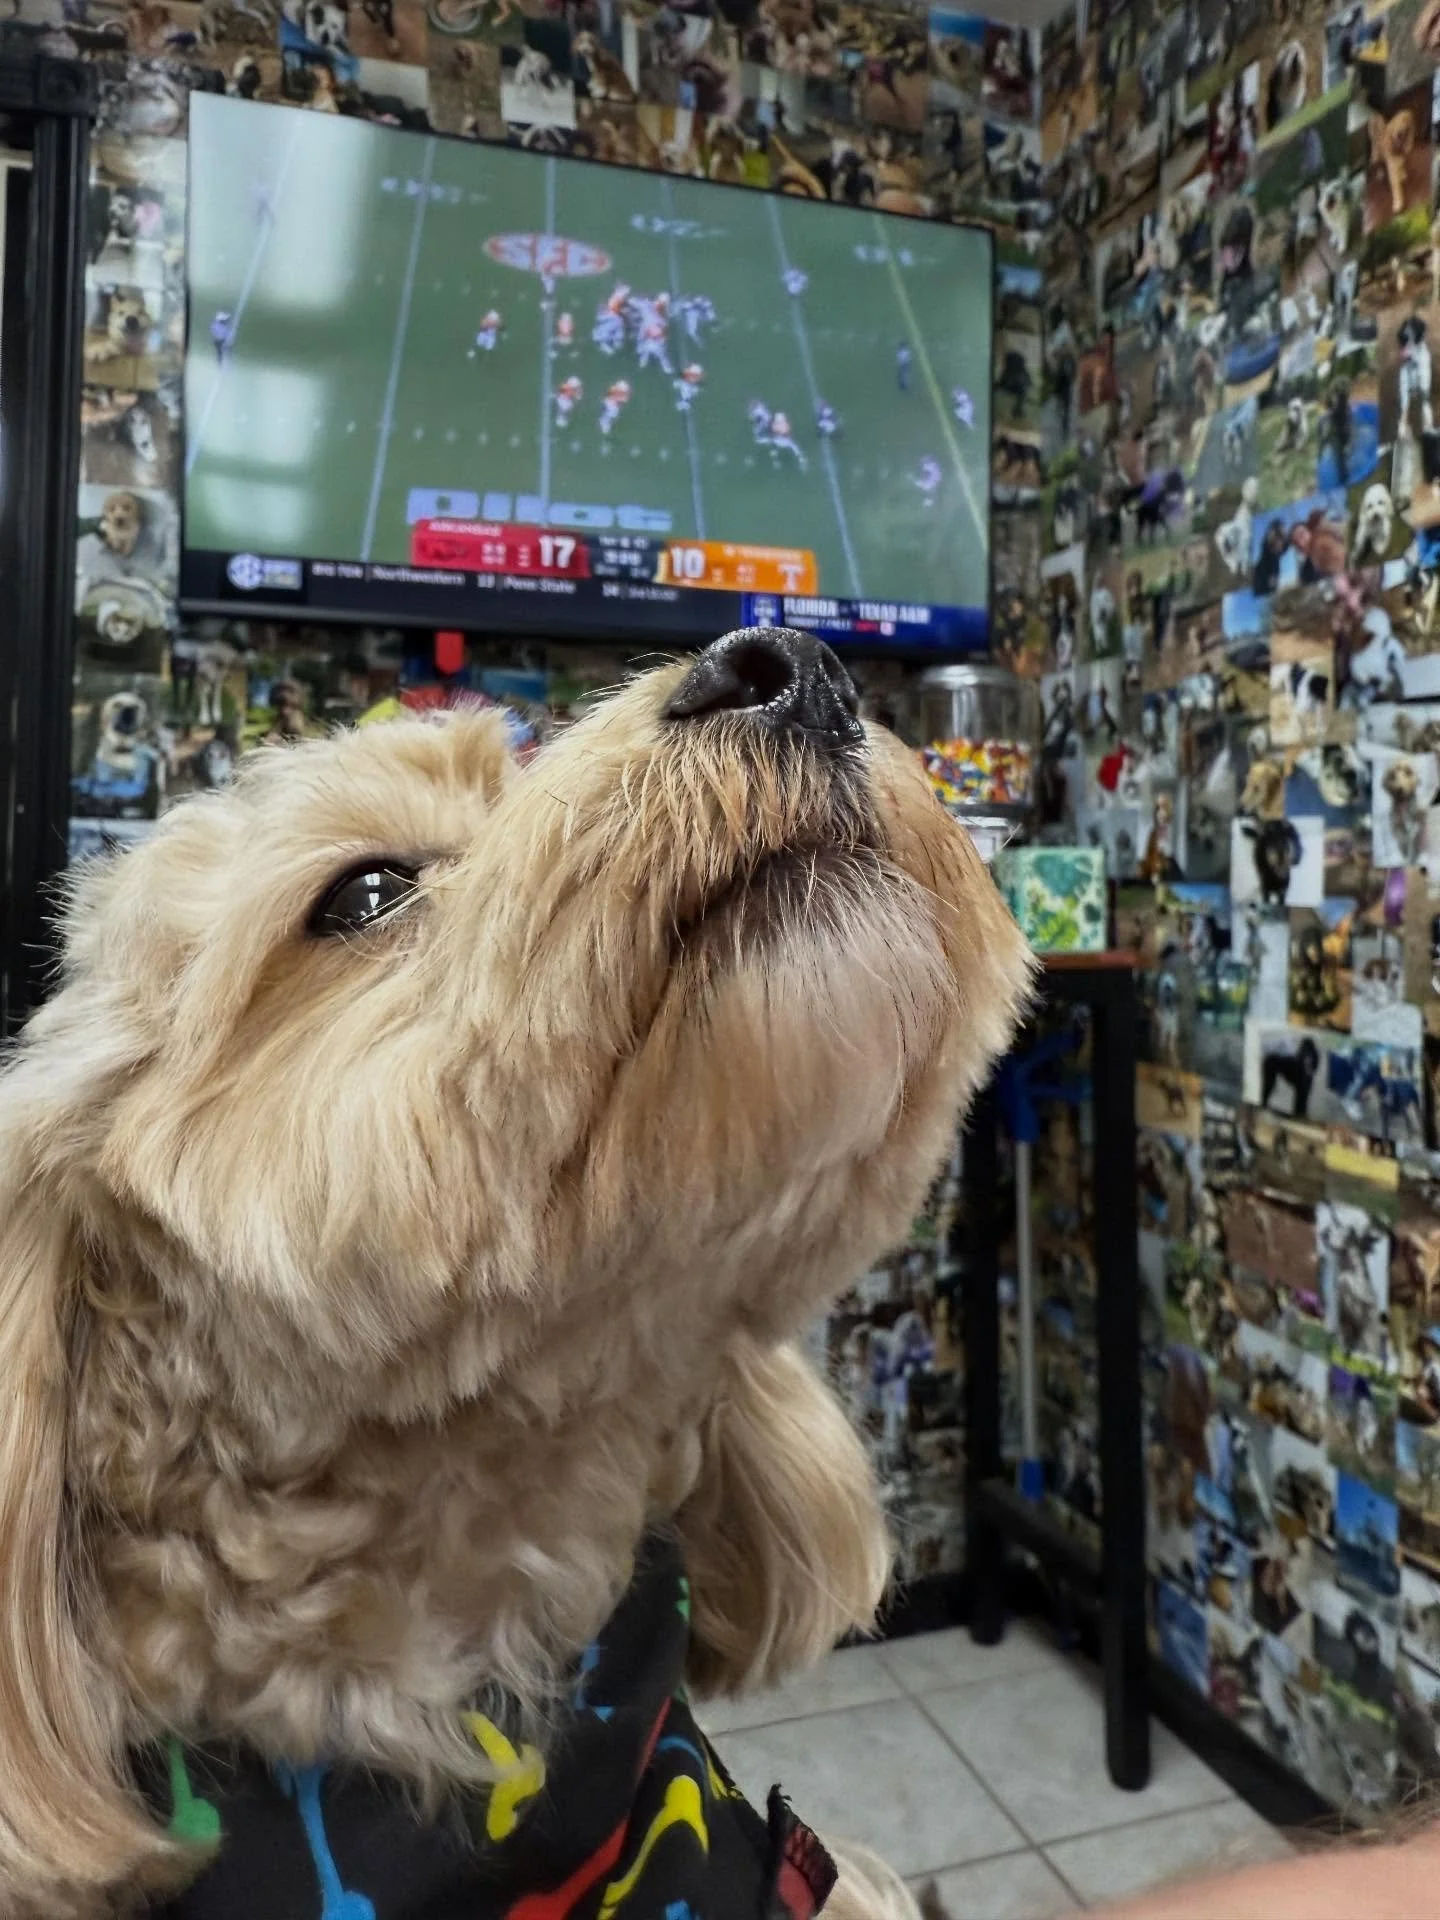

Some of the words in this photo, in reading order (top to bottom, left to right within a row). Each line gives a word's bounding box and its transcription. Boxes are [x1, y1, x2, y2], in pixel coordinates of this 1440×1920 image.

[538, 534, 576, 568] 17
[670, 546, 705, 579] 10
[784, 597, 839, 617] FLORIDA
[859, 603, 897, 621] TEXAS
